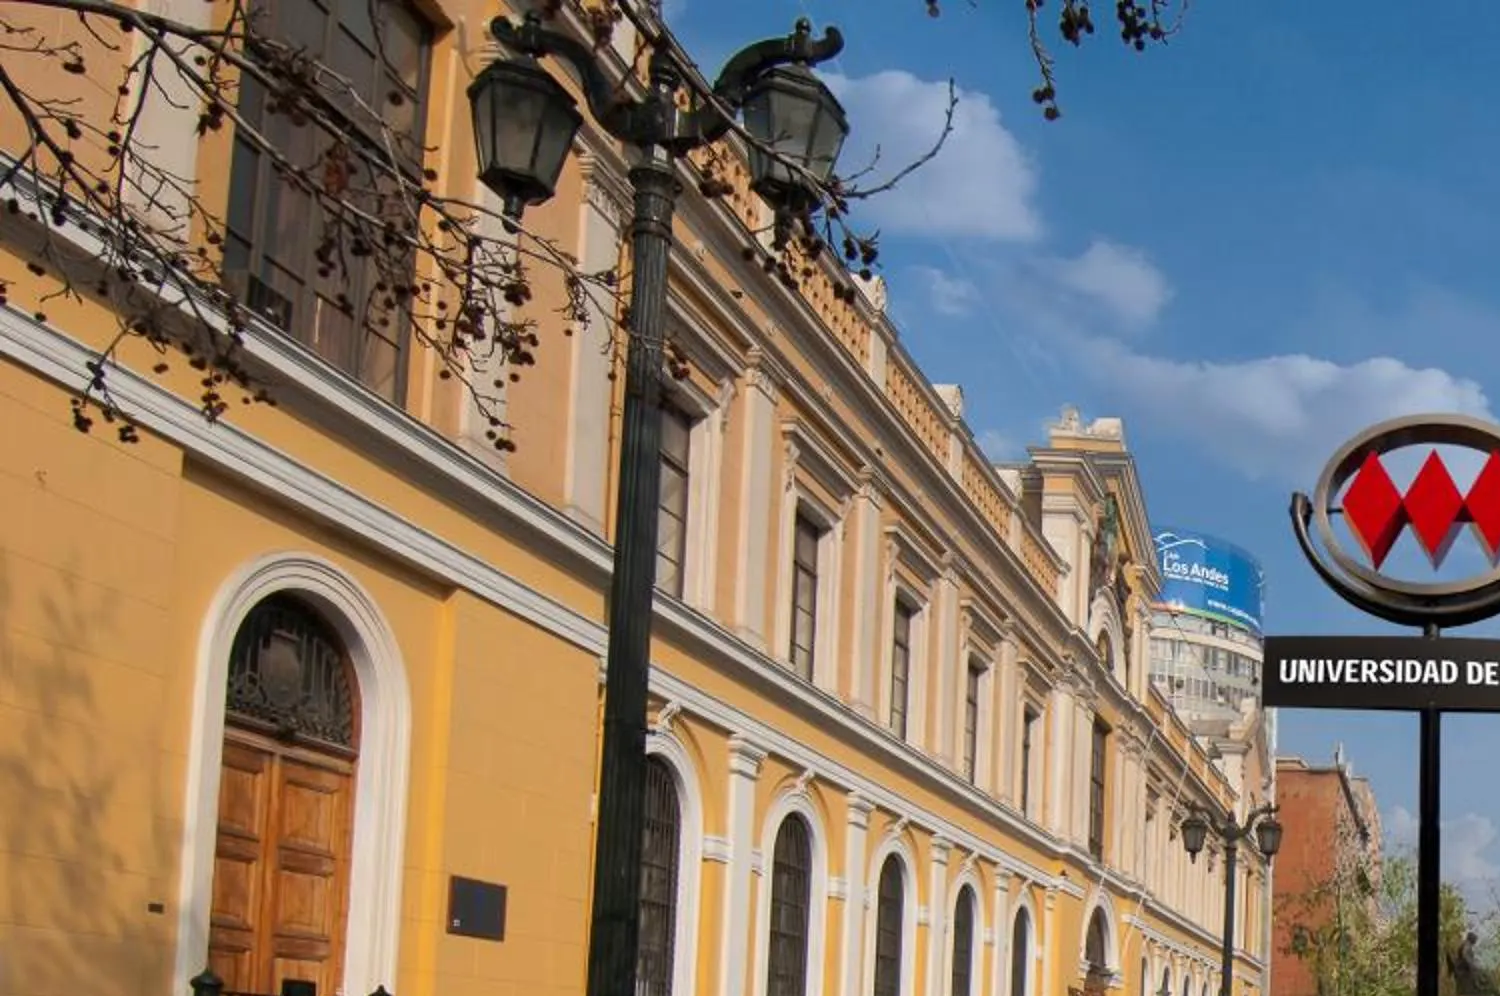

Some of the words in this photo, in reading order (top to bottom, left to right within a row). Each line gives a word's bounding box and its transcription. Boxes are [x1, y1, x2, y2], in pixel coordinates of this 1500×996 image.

[1163, 550, 1189, 574] Los
[1190, 563, 1229, 585] Andes
[1279, 659, 1458, 684] UNIVERSIDAD
[1466, 661, 1499, 685] DE
